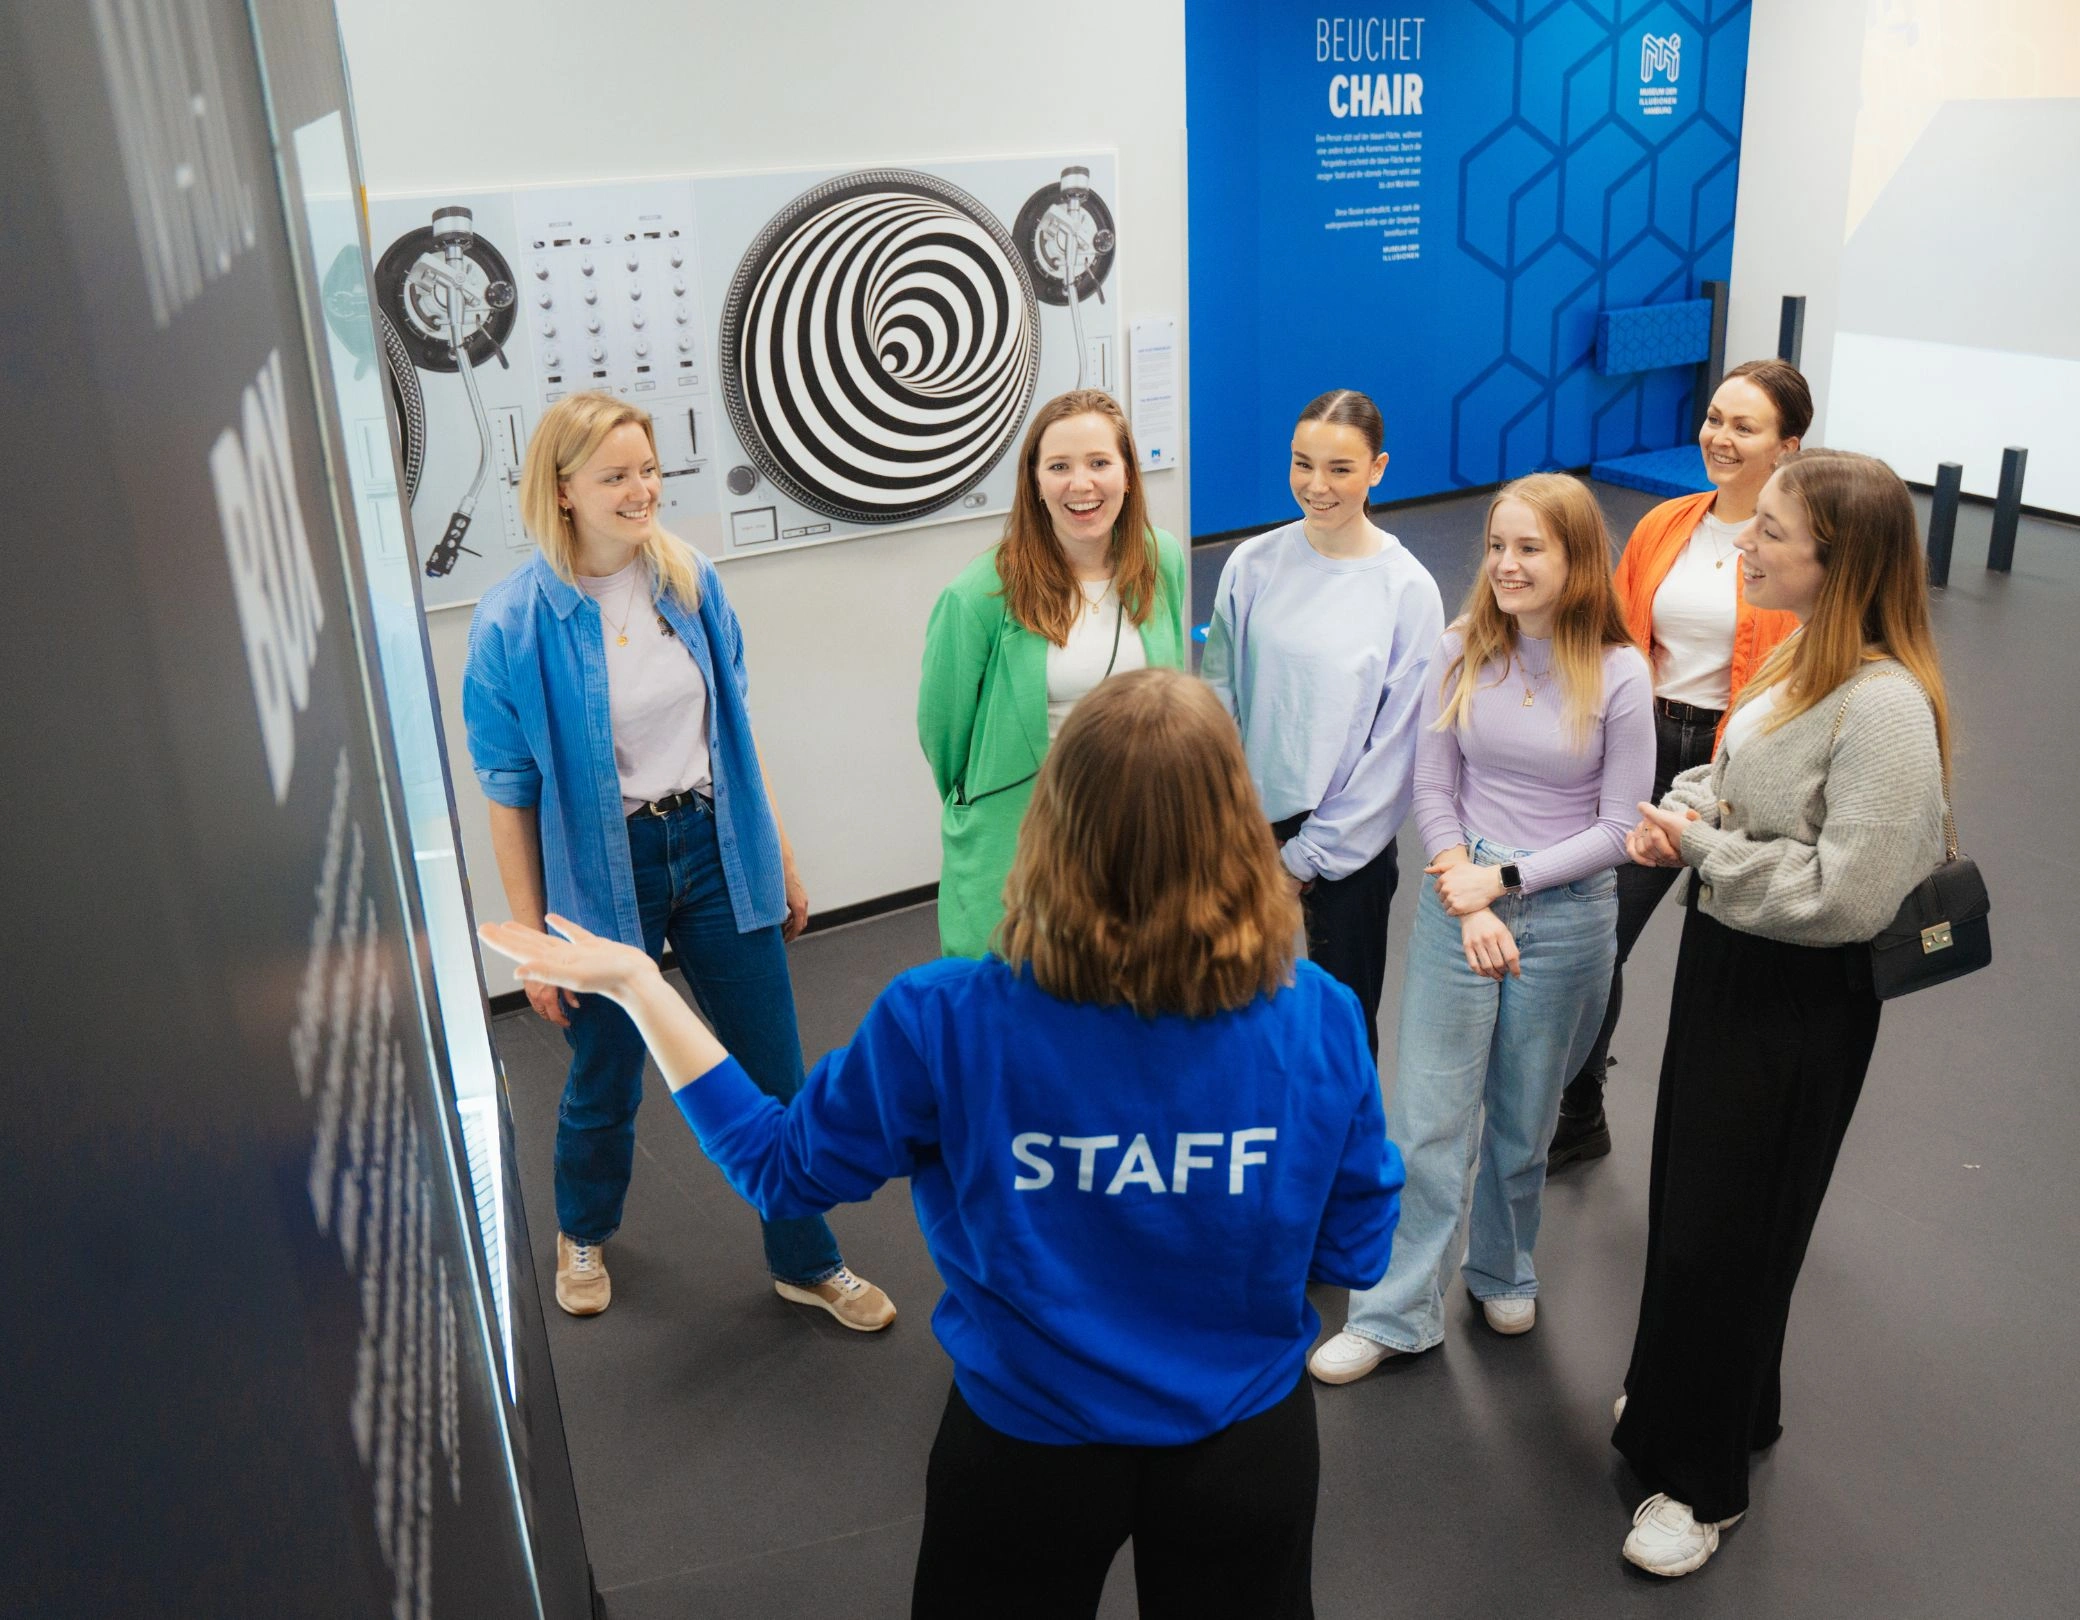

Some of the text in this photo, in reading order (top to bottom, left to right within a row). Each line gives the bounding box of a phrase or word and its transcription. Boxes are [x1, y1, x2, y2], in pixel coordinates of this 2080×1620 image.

[1316, 17, 1425, 62] BEUCHET
[1328, 73, 1424, 118] CHAIR
[1011, 1127, 1277, 1195] STAFF
